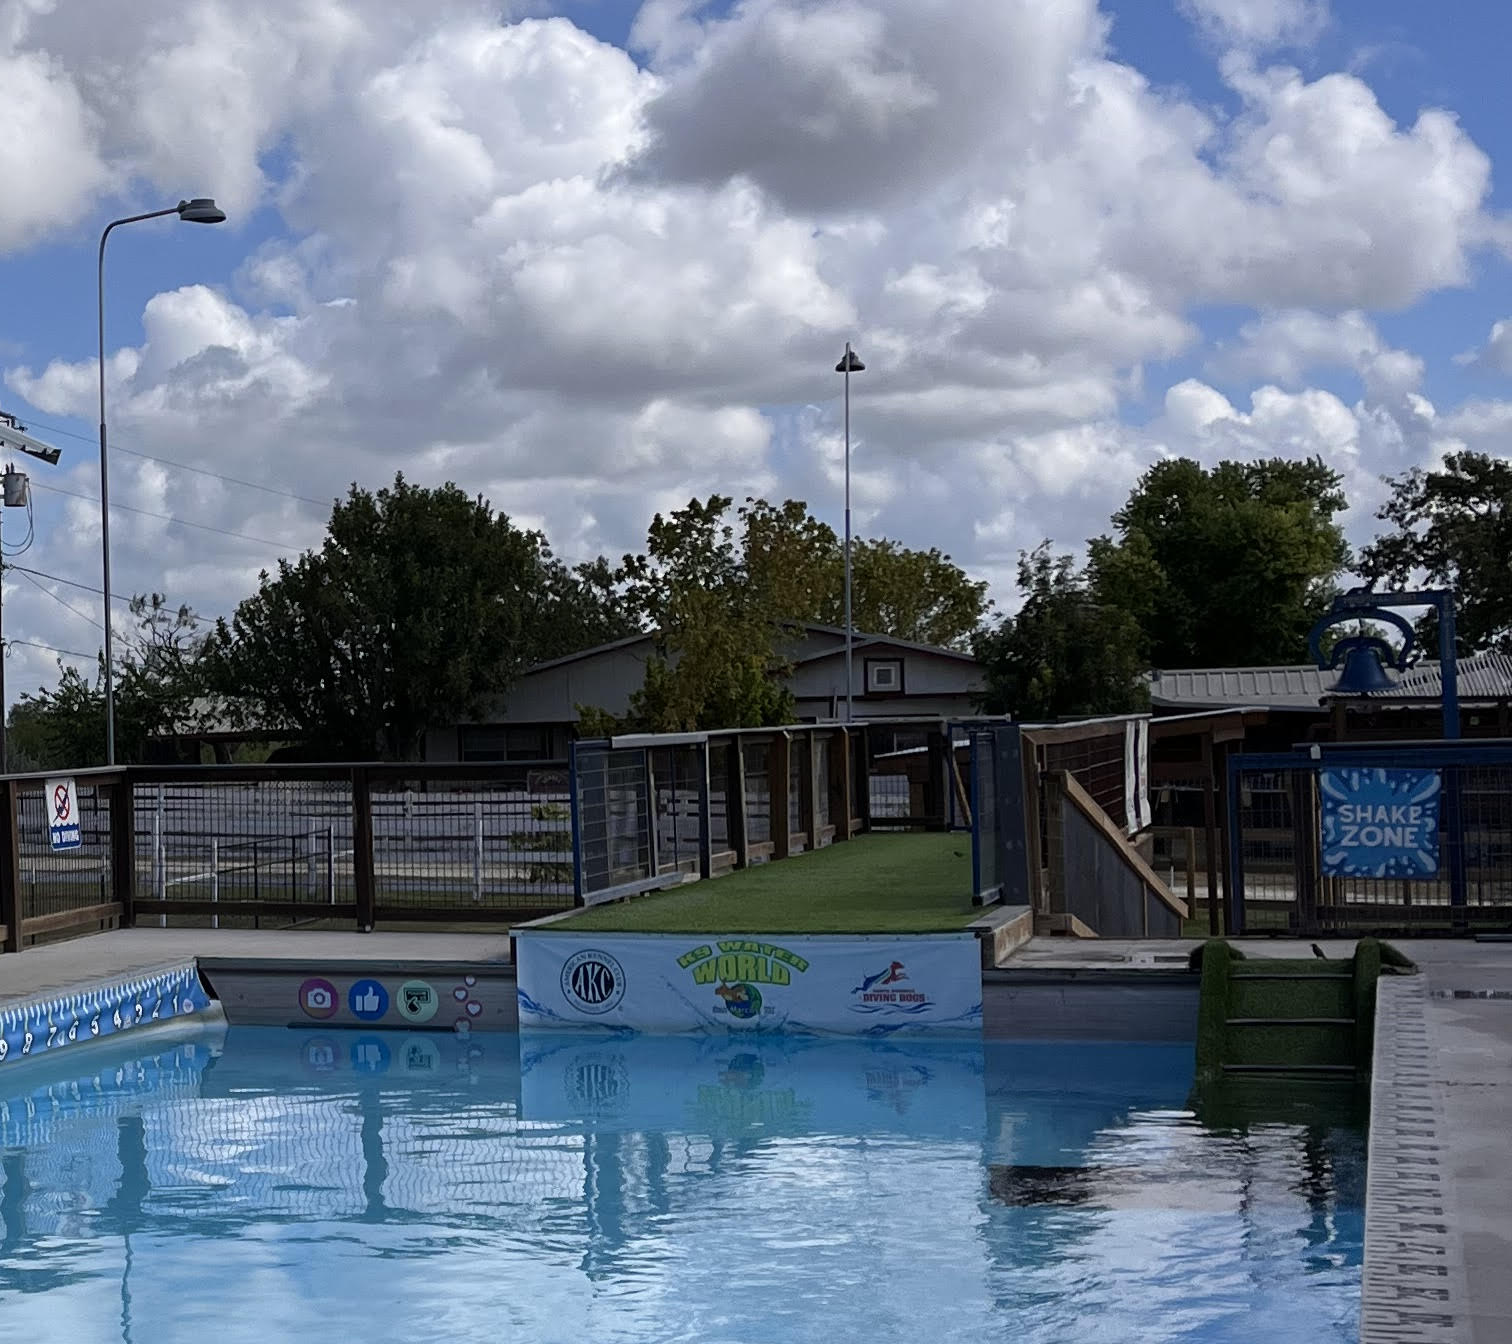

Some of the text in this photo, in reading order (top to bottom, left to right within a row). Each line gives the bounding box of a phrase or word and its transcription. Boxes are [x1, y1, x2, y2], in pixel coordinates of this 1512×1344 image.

[1338, 804, 1422, 824] SHAKE
[52, 828, 80, 844] NO DIVING
[1340, 825, 1419, 848] ZONE
[676, 940, 809, 973] K9 WATER
[575, 962, 612, 1004] AKC
[692, 955, 790, 985] WORLD
[863, 993, 925, 1002] DIVING DOGS
[23, 1032, 33, 1054] 8
[47, 1025, 57, 1047] 7
[69, 1020, 79, 1041] 6
[91, 1014, 100, 1035] 5
[113, 1008, 122, 1028] 4
[135, 1003, 143, 1023] 3
[152, 999, 161, 1018] 2
[173, 994, 178, 1013] 1
